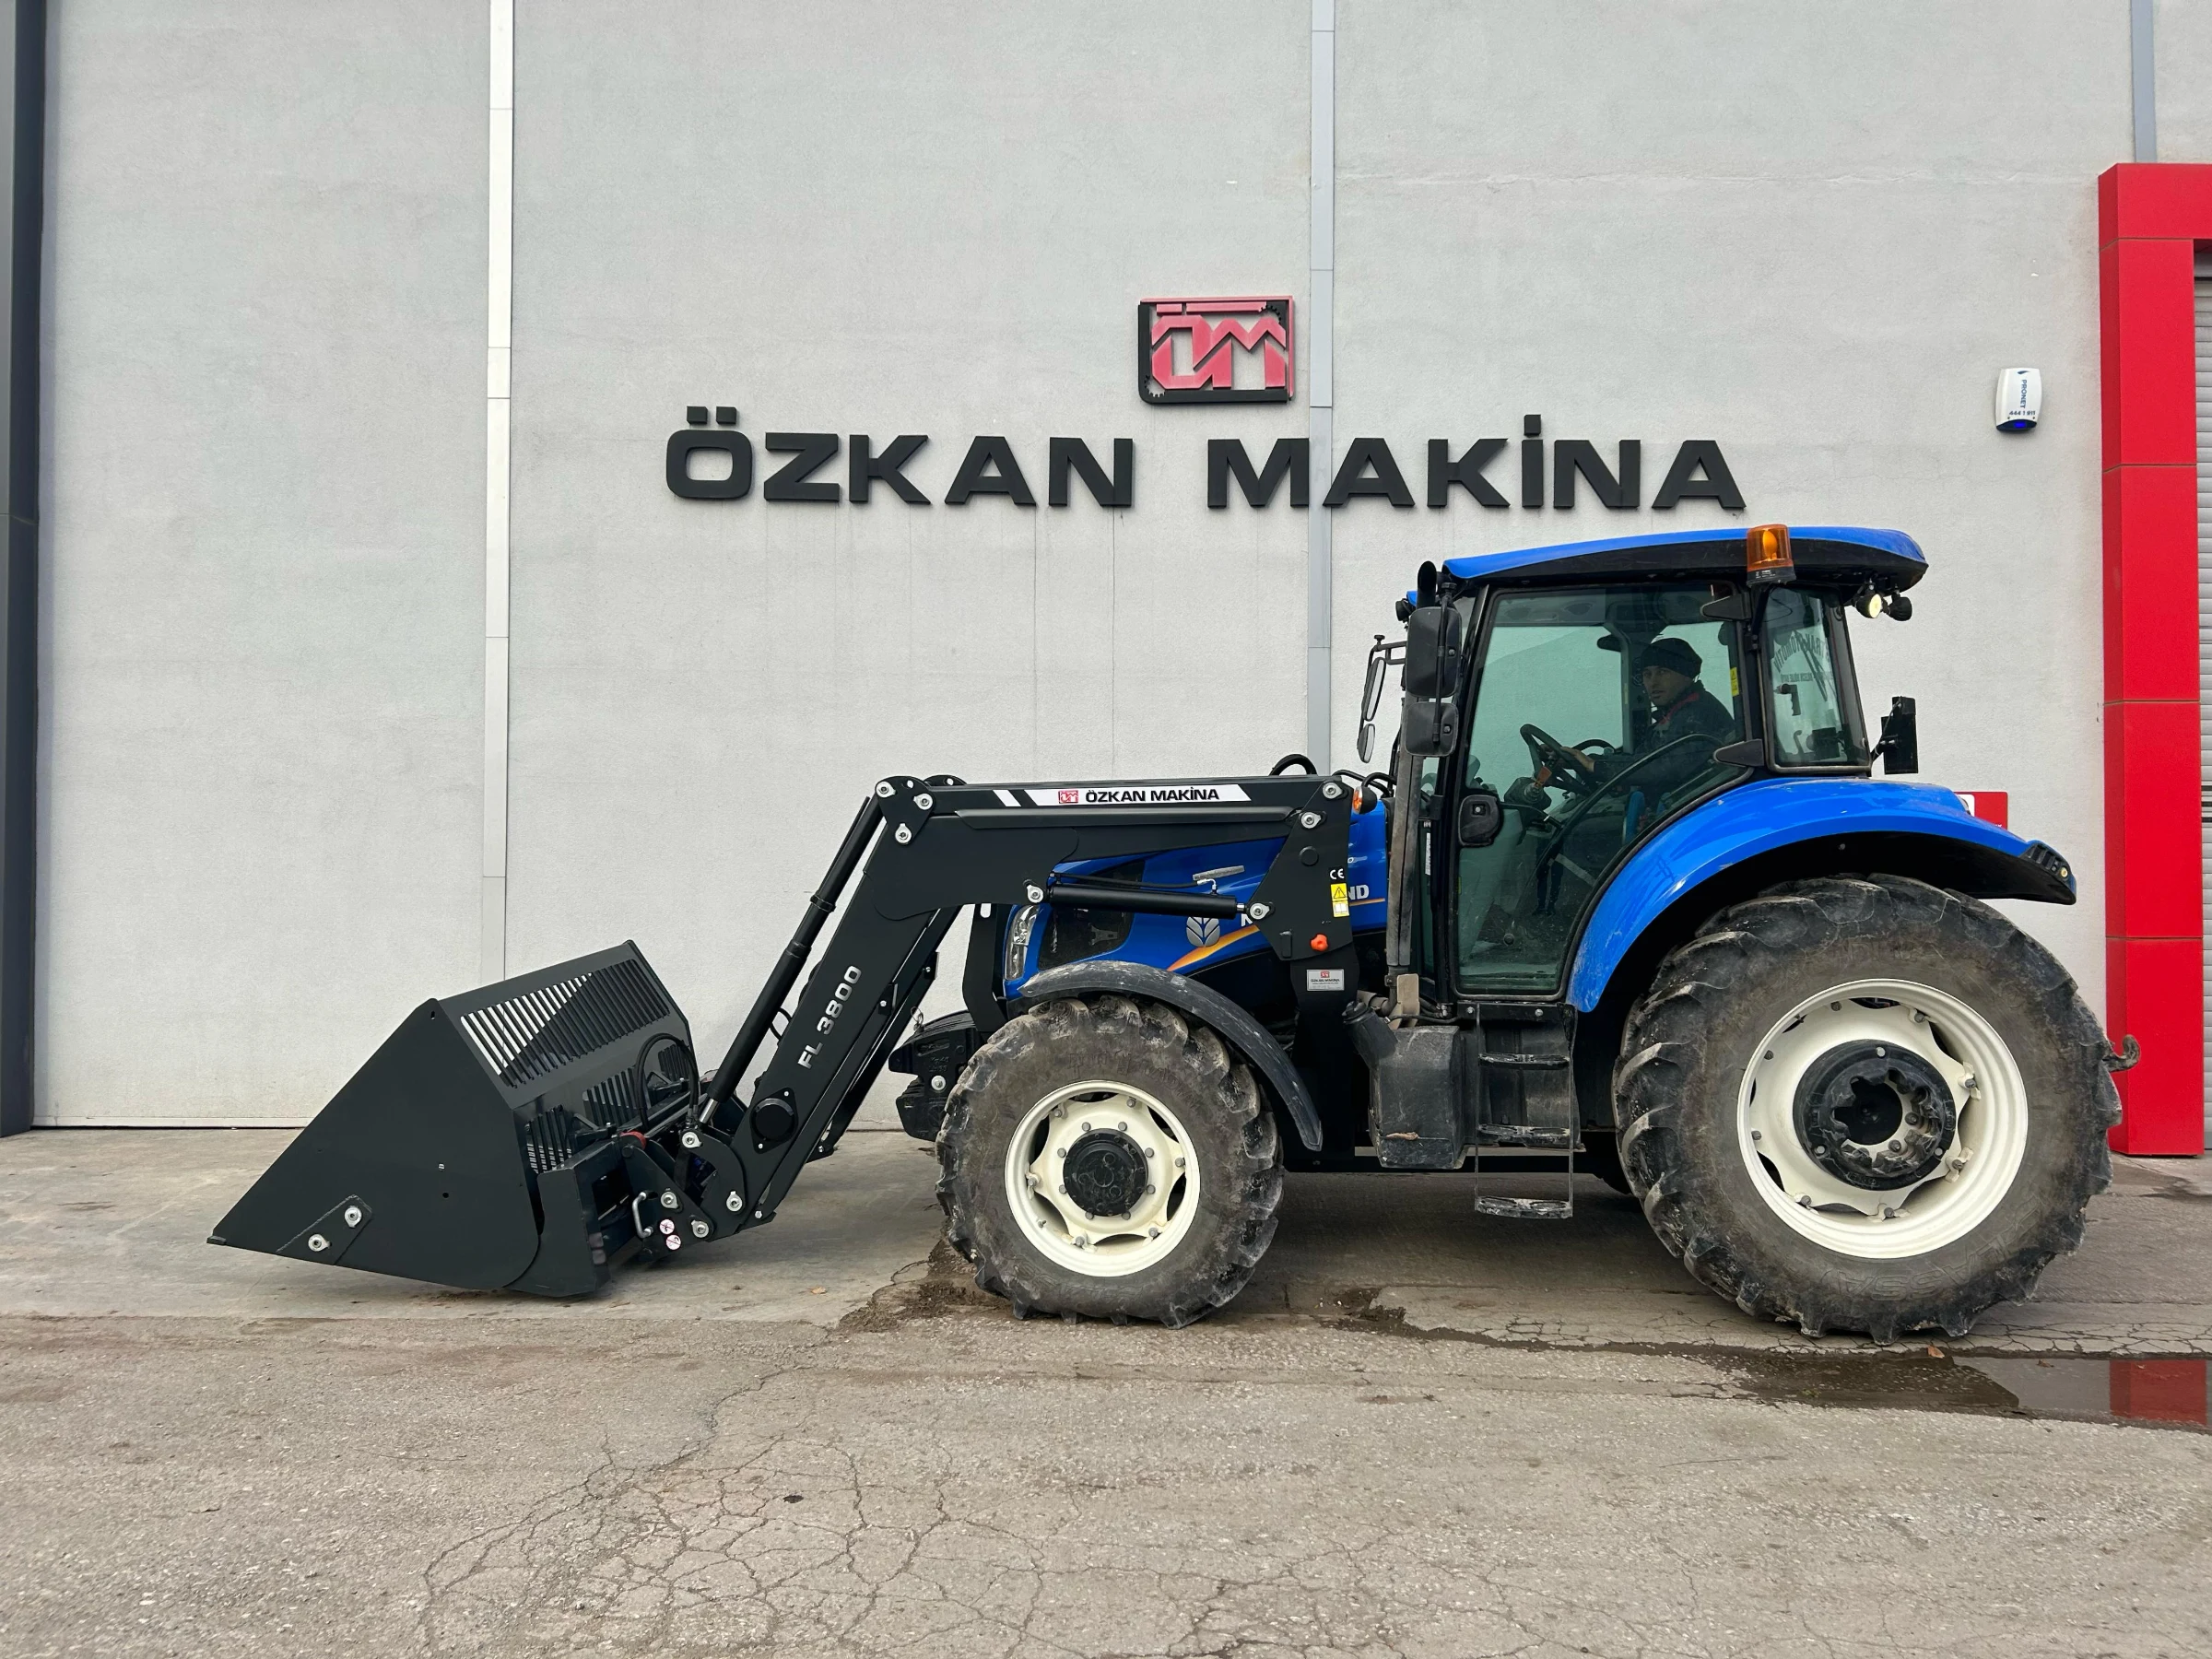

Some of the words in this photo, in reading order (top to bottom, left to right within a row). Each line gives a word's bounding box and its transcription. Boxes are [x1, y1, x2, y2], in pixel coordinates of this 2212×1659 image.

[666, 406, 1133, 507] ÖZKAN
[1207, 414, 1747, 509] MAKİNA
[1086, 790, 1146, 803] ÖZKAN
[1150, 787, 1219, 801] MAKİNA
[1330, 868, 1345, 879] CE
[797, 1041, 823, 1069] FL
[817, 965, 862, 1035] 3800
